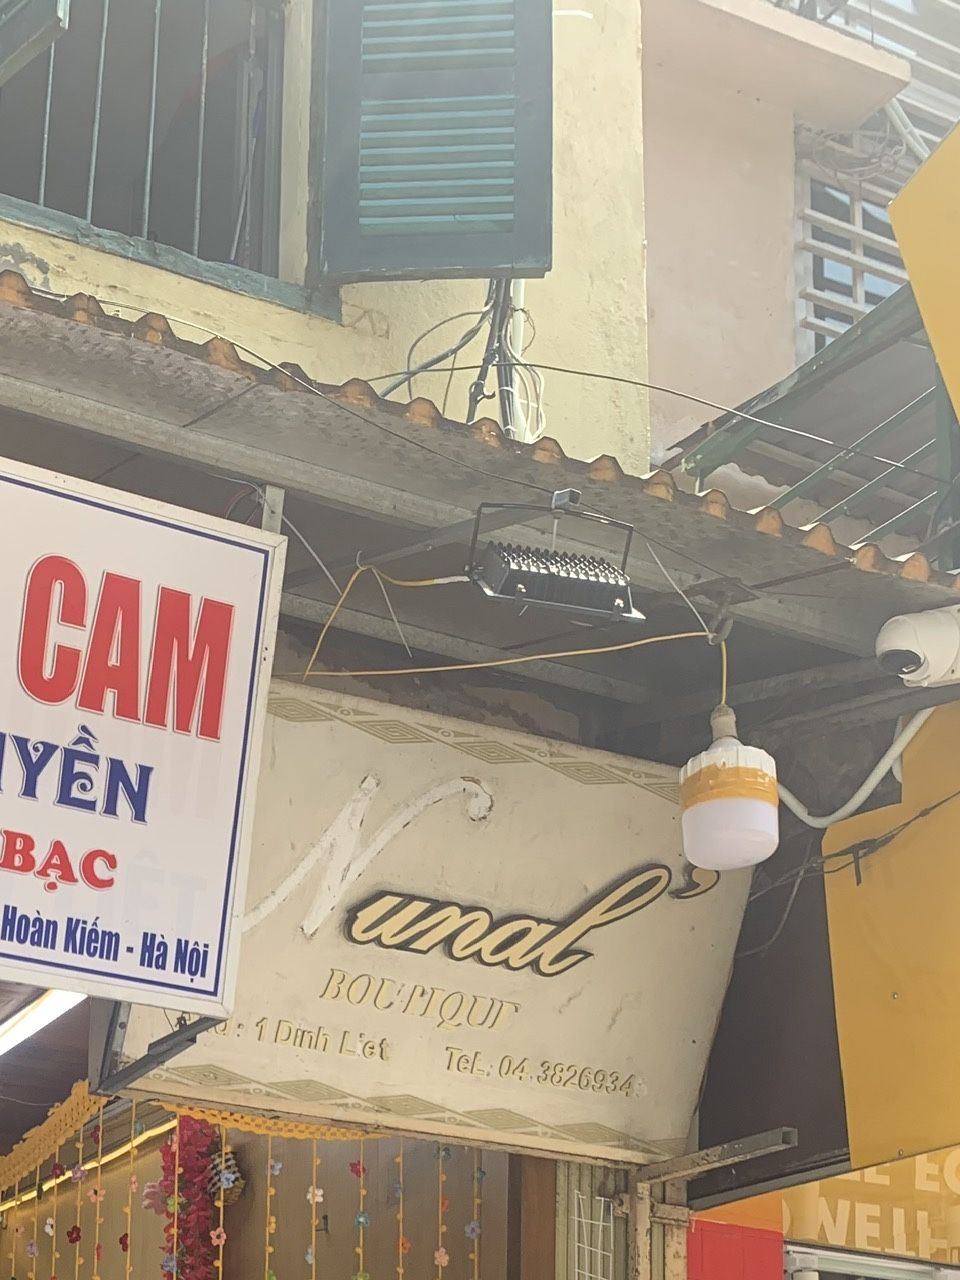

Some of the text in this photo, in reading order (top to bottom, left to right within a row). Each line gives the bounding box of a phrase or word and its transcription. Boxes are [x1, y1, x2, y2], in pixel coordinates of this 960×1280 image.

[17, 553, 236, 740] CAM
[0, 904, 59, 951] Hoàn
[63, 915, 121, 962] Kiếm
[139, 931, 167, 971] Hà
[173, 937, 210, 984] Nội
